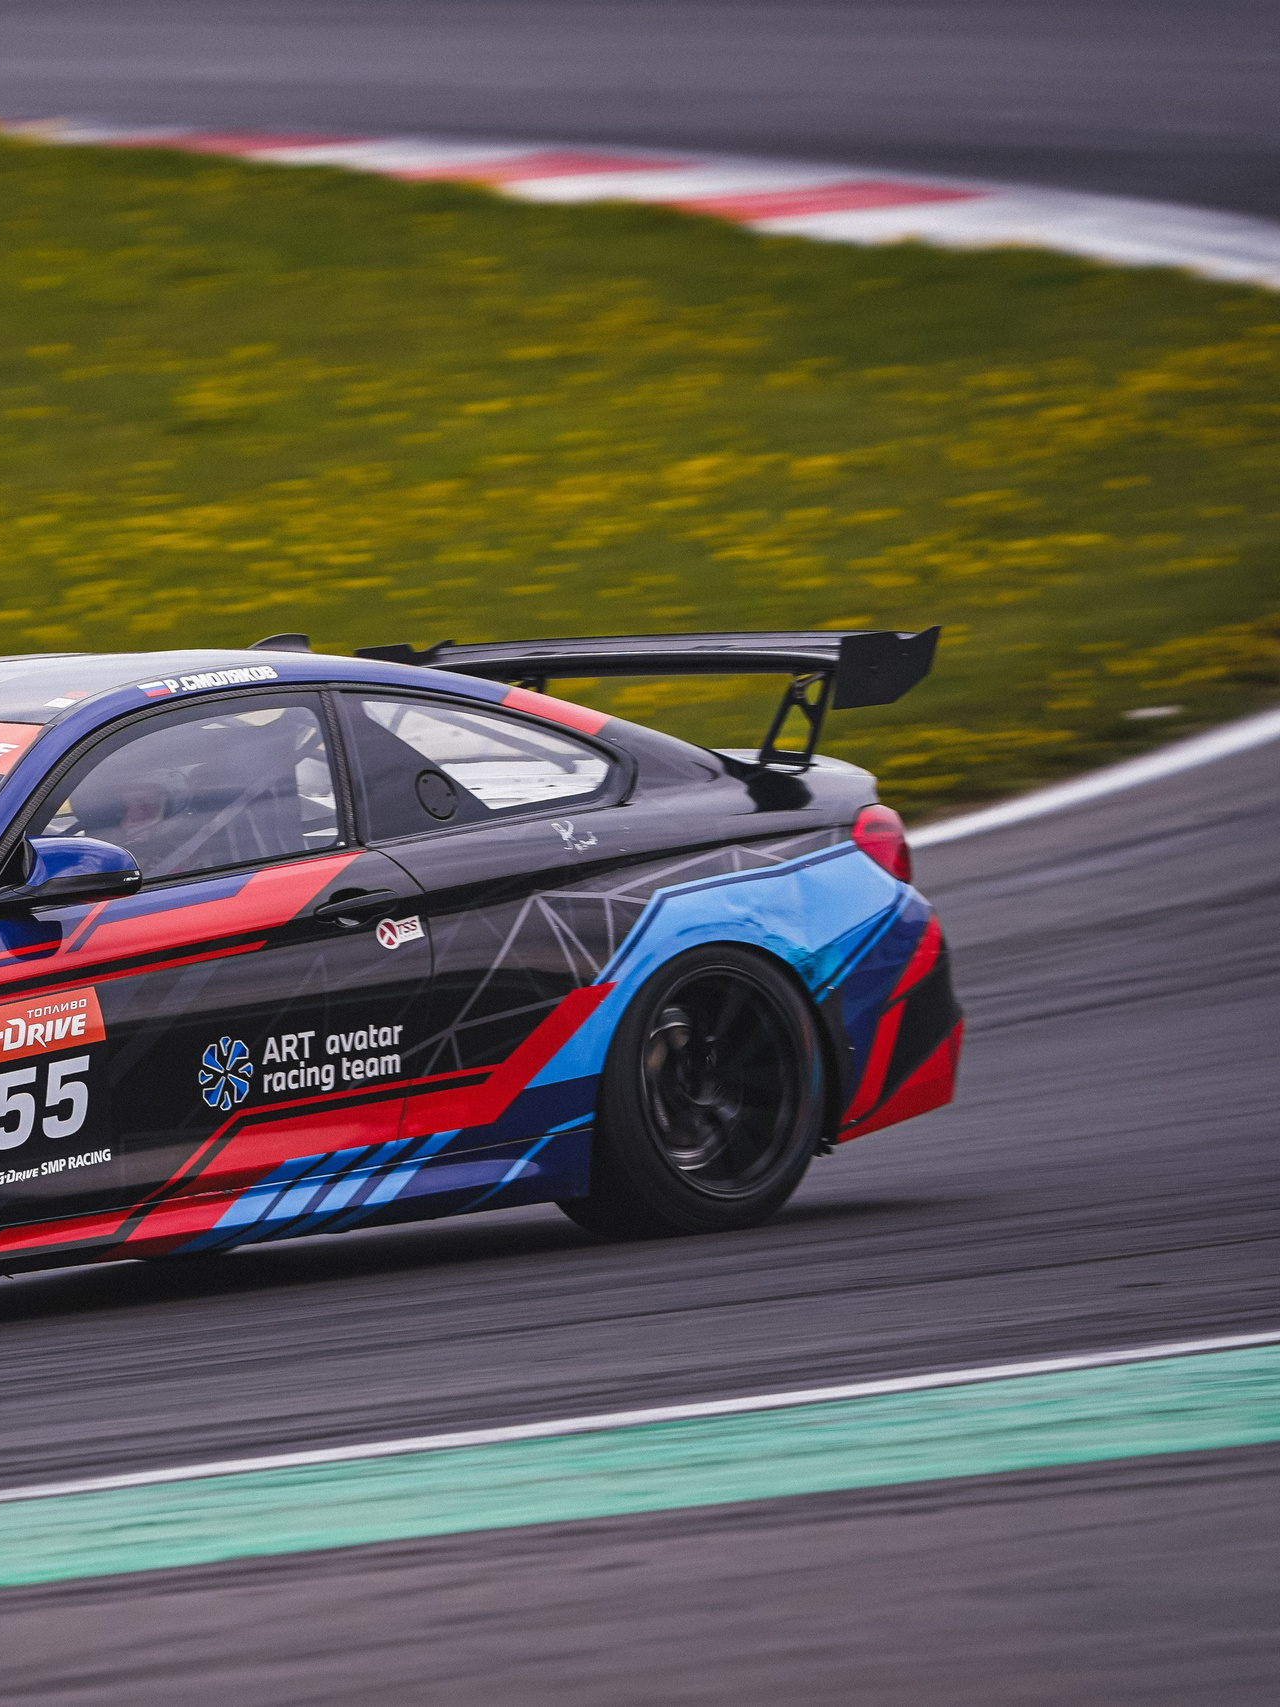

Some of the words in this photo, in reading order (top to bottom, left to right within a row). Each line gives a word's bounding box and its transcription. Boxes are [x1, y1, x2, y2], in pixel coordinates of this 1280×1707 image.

[26, 998, 87, 1018] ТОПЛИВО
[262, 1030, 316, 1065] ART
[325, 1024, 403, 1055] avatar
[263, 1061, 335, 1093] racing
[341, 1053, 401, 1081] team
[40, 1158, 67, 1175] SMP
[68, 1148, 112, 1170] RACING
